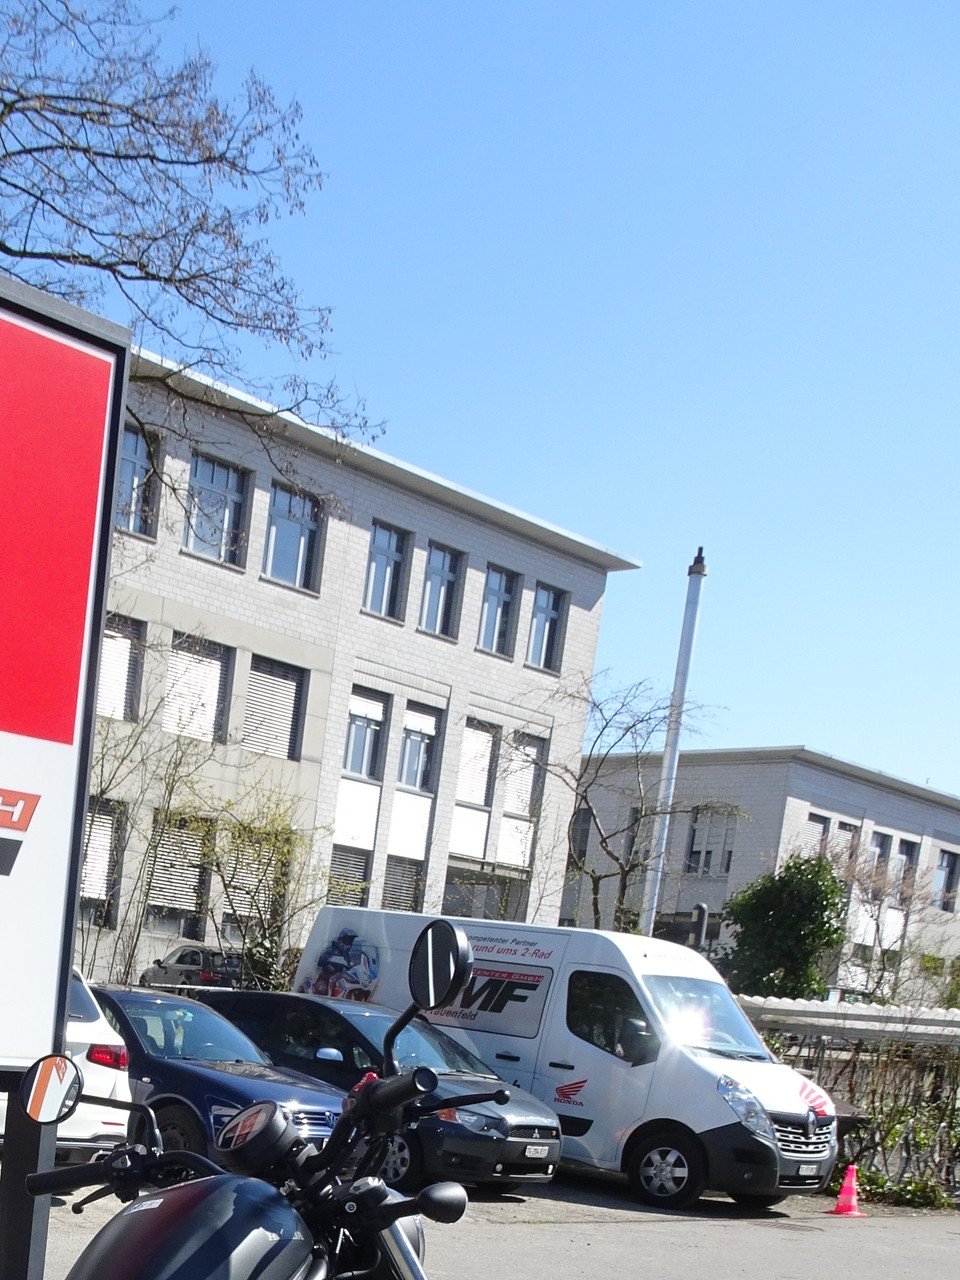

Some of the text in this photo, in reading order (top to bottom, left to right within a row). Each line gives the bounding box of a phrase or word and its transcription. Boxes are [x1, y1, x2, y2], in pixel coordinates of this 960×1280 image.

[467, 934, 539, 947] ompetenter Partner
[472, 944, 554, 959] rund ums 2-Rad
[451, 976, 539, 1014] MF
[553, 1097, 584, 1107] HONDA
